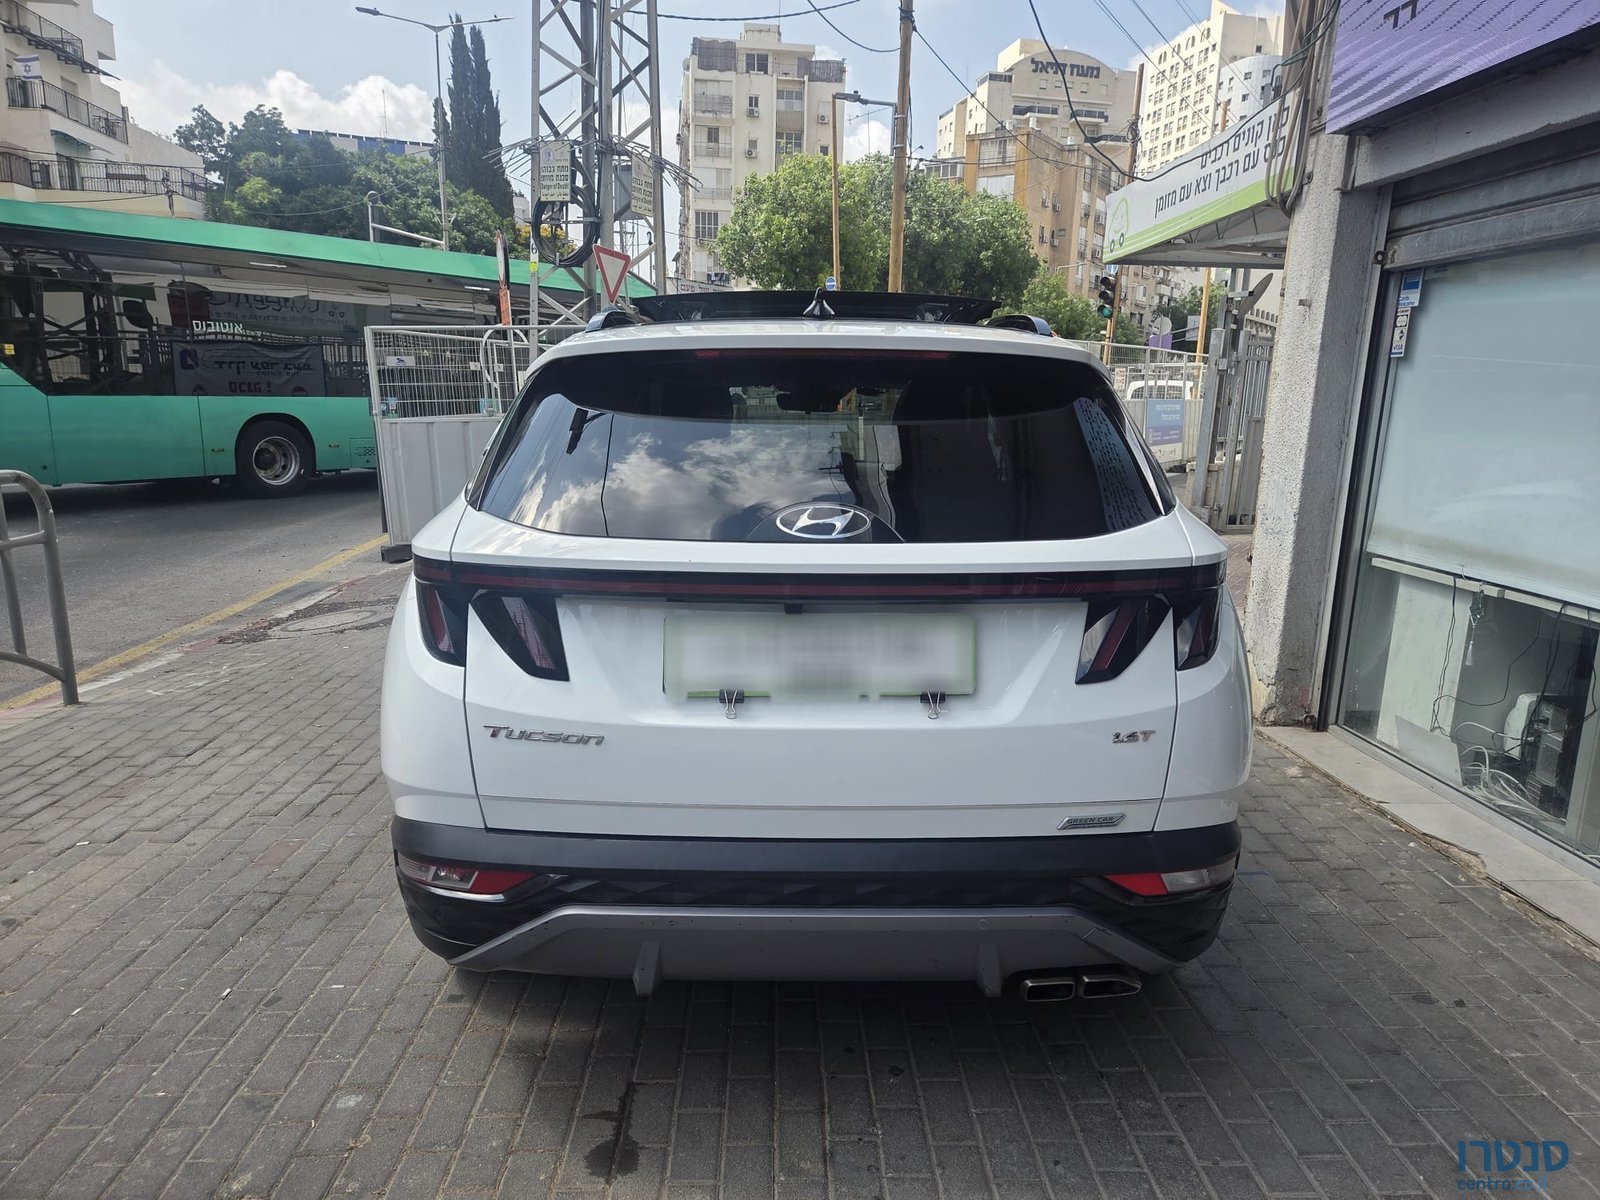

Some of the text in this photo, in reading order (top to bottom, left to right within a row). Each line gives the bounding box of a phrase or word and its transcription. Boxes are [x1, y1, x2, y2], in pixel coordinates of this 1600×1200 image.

[1232, 120, 1265, 153] קונים
[1200, 140, 1230, 169] רכבים
[1242, 148, 1260, 174] עם
[1194, 172, 1212, 197] וצא
[1215, 159, 1240, 192] רכבך
[1154, 189, 1177, 219] מזומן
[1179, 182, 1192, 203] עם
[192, 320, 243, 334] אוטובוס
